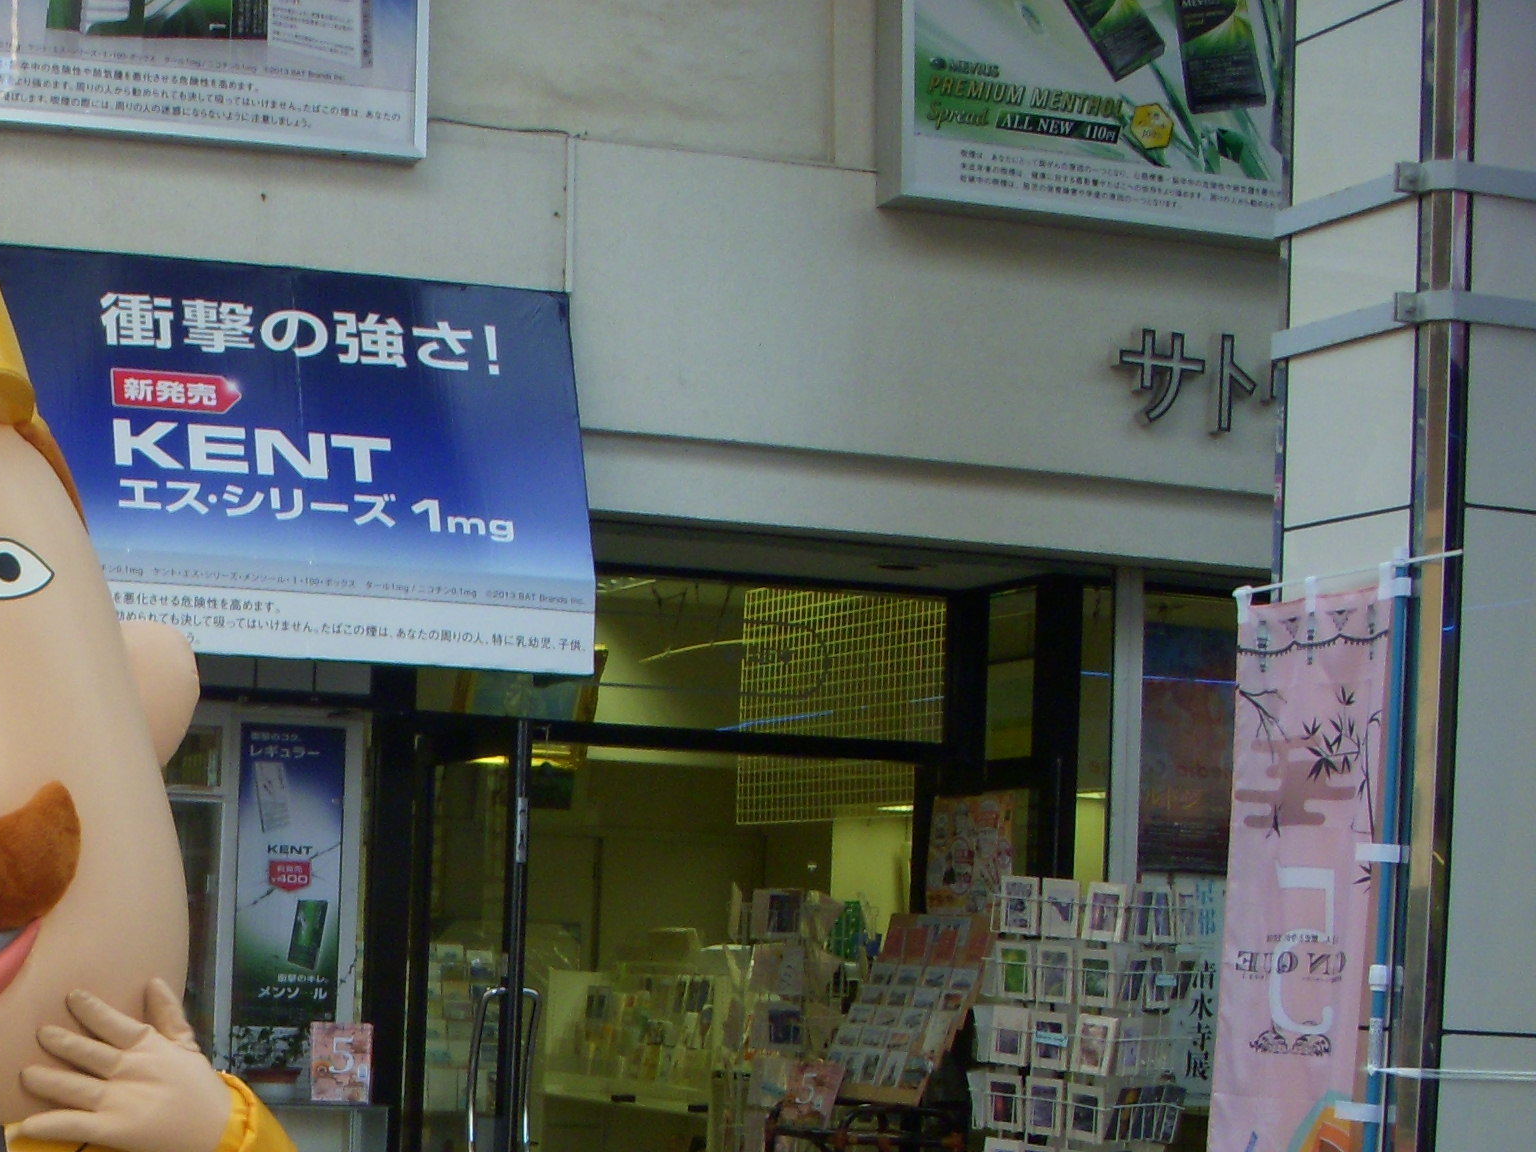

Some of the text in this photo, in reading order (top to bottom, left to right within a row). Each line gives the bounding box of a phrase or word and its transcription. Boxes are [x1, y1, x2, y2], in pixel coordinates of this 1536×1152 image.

[927, 74, 1124, 119] PREMIUM MENTHOL
[927, 101, 989, 131] Spread
[1001, 113, 1031, 131] ALL
[1037, 117, 1074, 136] NEW
[123, 375, 218, 407] 新発売
[1119, 328, 1276, 432] サト
[112, 418, 391, 482] KENT
[118, 479, 515, 543] エス・シリーズ 1mg
[267, 844, 313, 856] KENT
[258, 985, 328, 1001] メンソル
